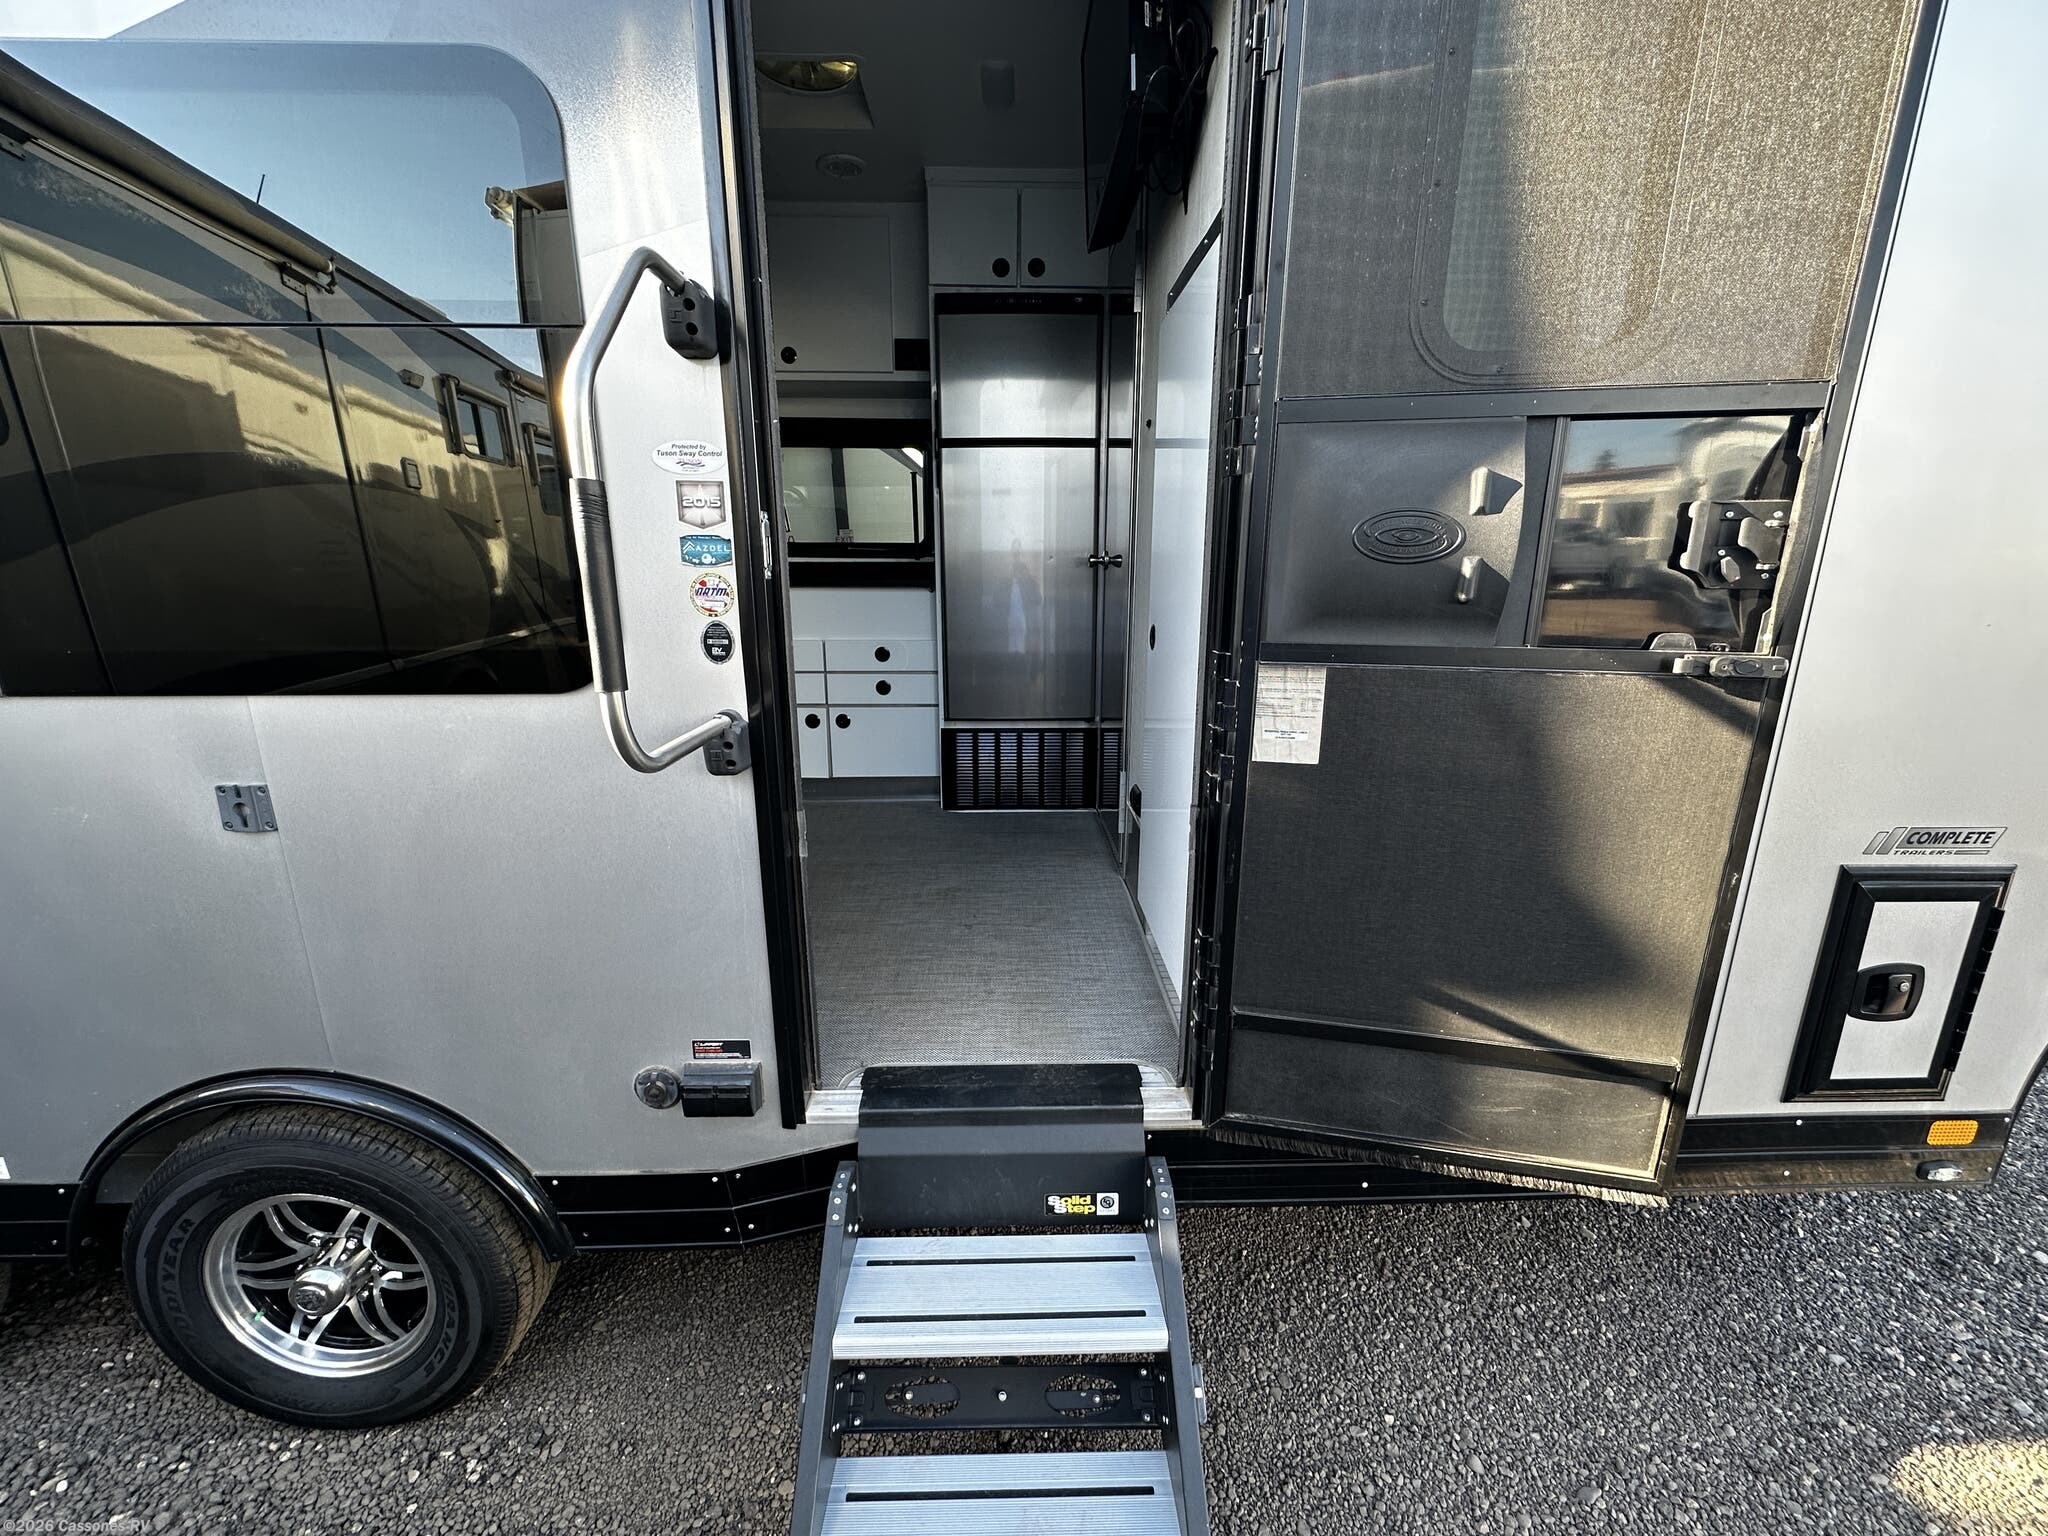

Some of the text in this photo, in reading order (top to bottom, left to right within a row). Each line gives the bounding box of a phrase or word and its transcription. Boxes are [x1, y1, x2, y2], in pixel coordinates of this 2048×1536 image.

[699, 443, 706, 451] by
[656, 449, 677, 457] Tuson
[678, 450, 696, 458] Sway
[695, 544, 731, 552] AZDEL
[1906, 831, 1996, 844] COMPLETE
[1047, 1195, 1091, 1206] Solid
[1054, 1203, 1096, 1214] Step
